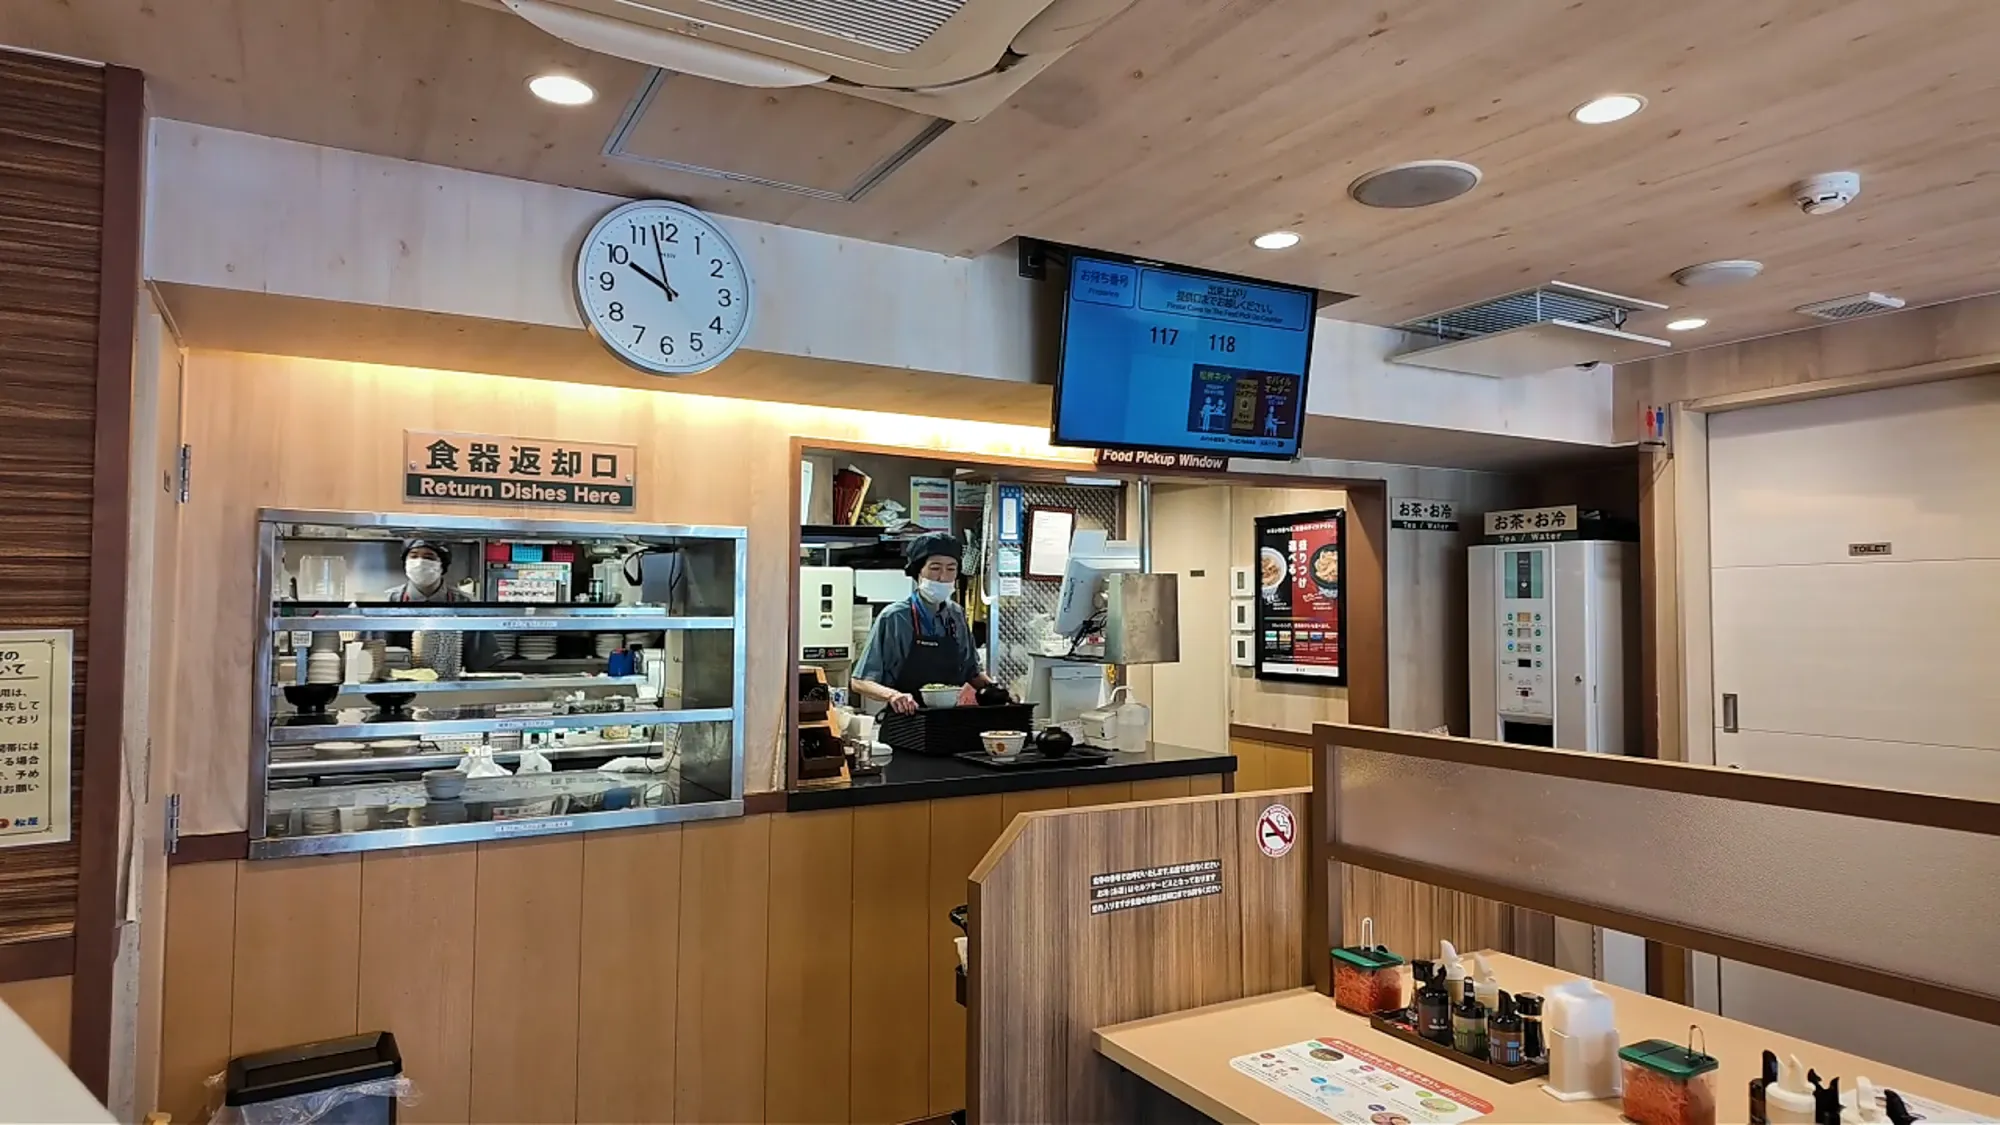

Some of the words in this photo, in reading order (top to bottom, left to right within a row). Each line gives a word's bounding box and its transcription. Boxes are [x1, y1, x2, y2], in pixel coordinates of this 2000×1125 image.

[630, 225, 646, 246] 11
[657, 221, 679, 244] 12
[607, 244, 629, 265] 10
[694, 235, 701, 255] 1
[710, 259, 724, 278] 2
[599, 271, 615, 291] 9
[718, 288, 731, 307] 3
[608, 301, 624, 321] 8
[632, 325, 646, 344] 7
[709, 316, 724, 335] 4
[660, 336, 674, 355] 6
[690, 332, 703, 351] 5
[1150, 326, 1179, 346] 117
[1209, 334, 1236, 353] 118
[426, 439, 618, 478] 食器返却口
[1103, 449, 1133, 462] Food
[1135, 451, 1175, 467] Pickup
[1179, 454, 1223, 469] Window
[420, 477, 493, 498] Return
[501, 481, 567, 501] Dishes
[574, 485, 621, 504] Here
[1399, 502, 1453, 520] お茶・お冷
[1494, 510, 1567, 530] お茶・お冷
[1403, 521, 1416, 529] Tea
[1427, 522, 1449, 531] Water
[1500, 534, 1516, 542] Tea
[1531, 532, 1562, 541] Water
[1852, 544, 1887, 553] TOILET
[0, 755, 39, 766] る場合
[0, 784, 39, 795] お願い
